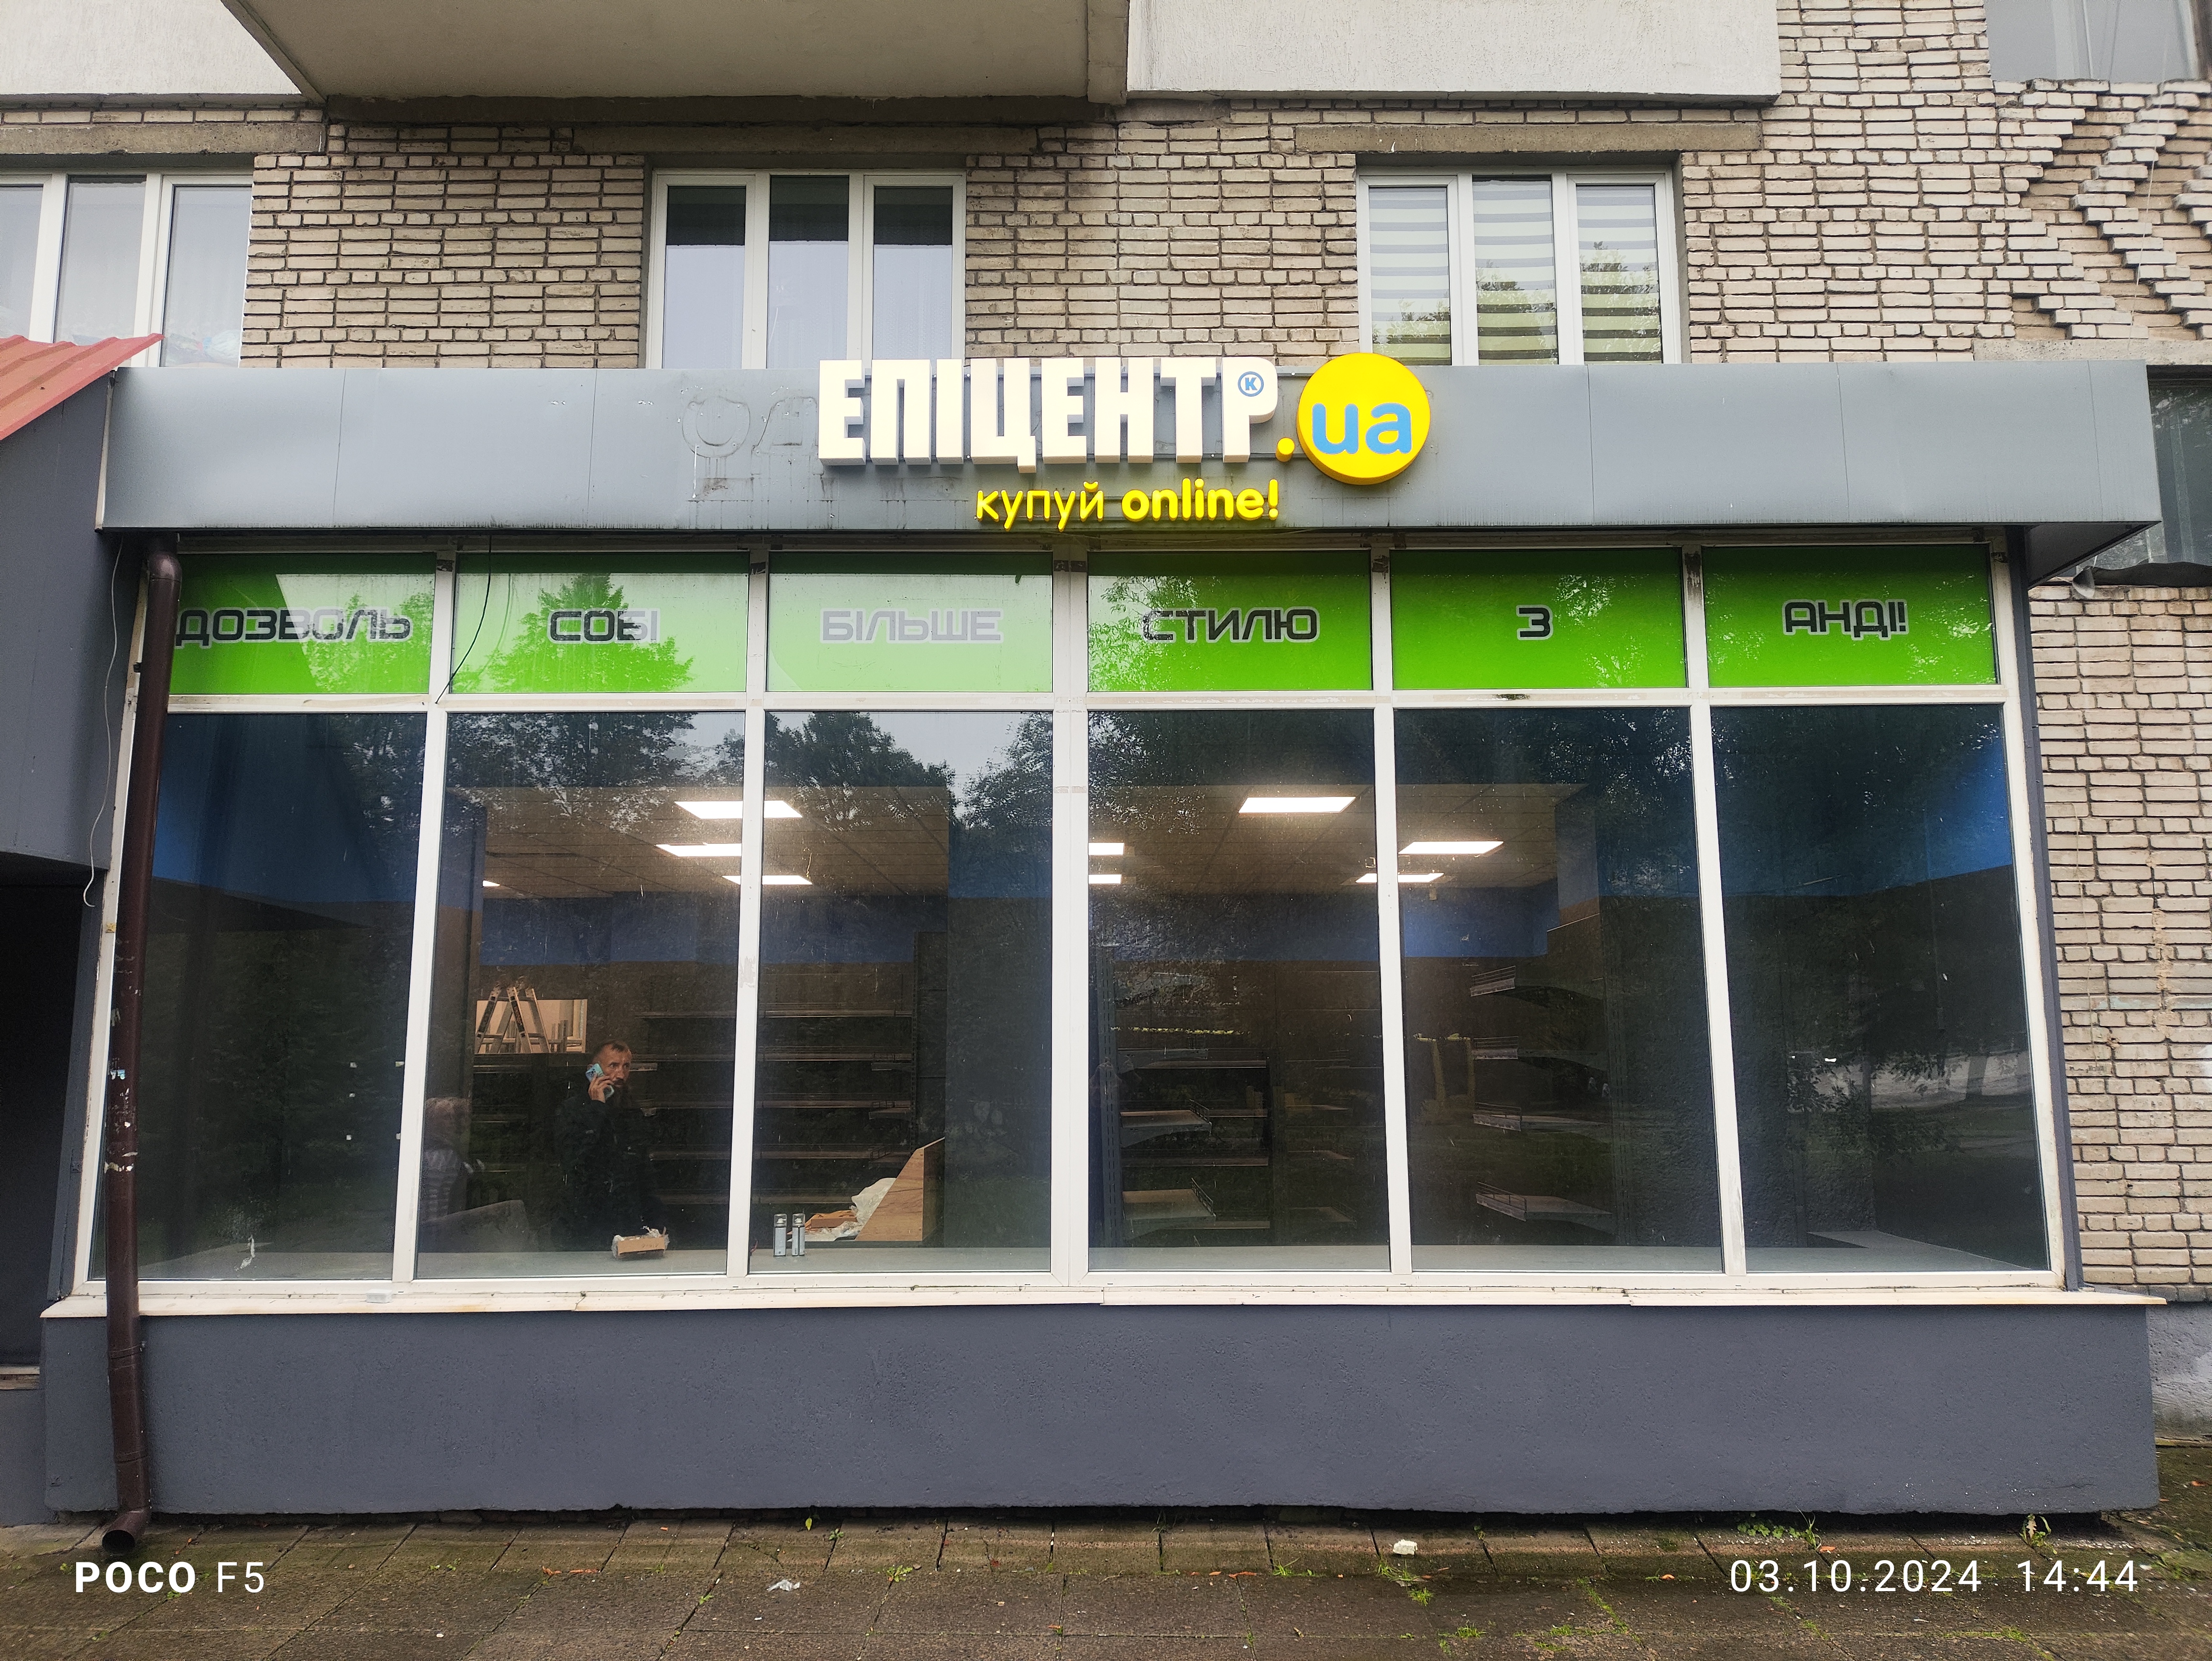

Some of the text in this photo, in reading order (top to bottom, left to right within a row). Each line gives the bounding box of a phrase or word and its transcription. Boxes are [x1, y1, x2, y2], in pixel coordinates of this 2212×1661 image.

[976, 478, 1279, 531] купуй online!
[175, 609, 411, 647] ДОЗВОЛЬ
[550, 610, 658, 642] СОБІ
[822, 611, 1001, 641] БІЛЬШЕ
[1142, 609, 1317, 641] СТИЛЮ
